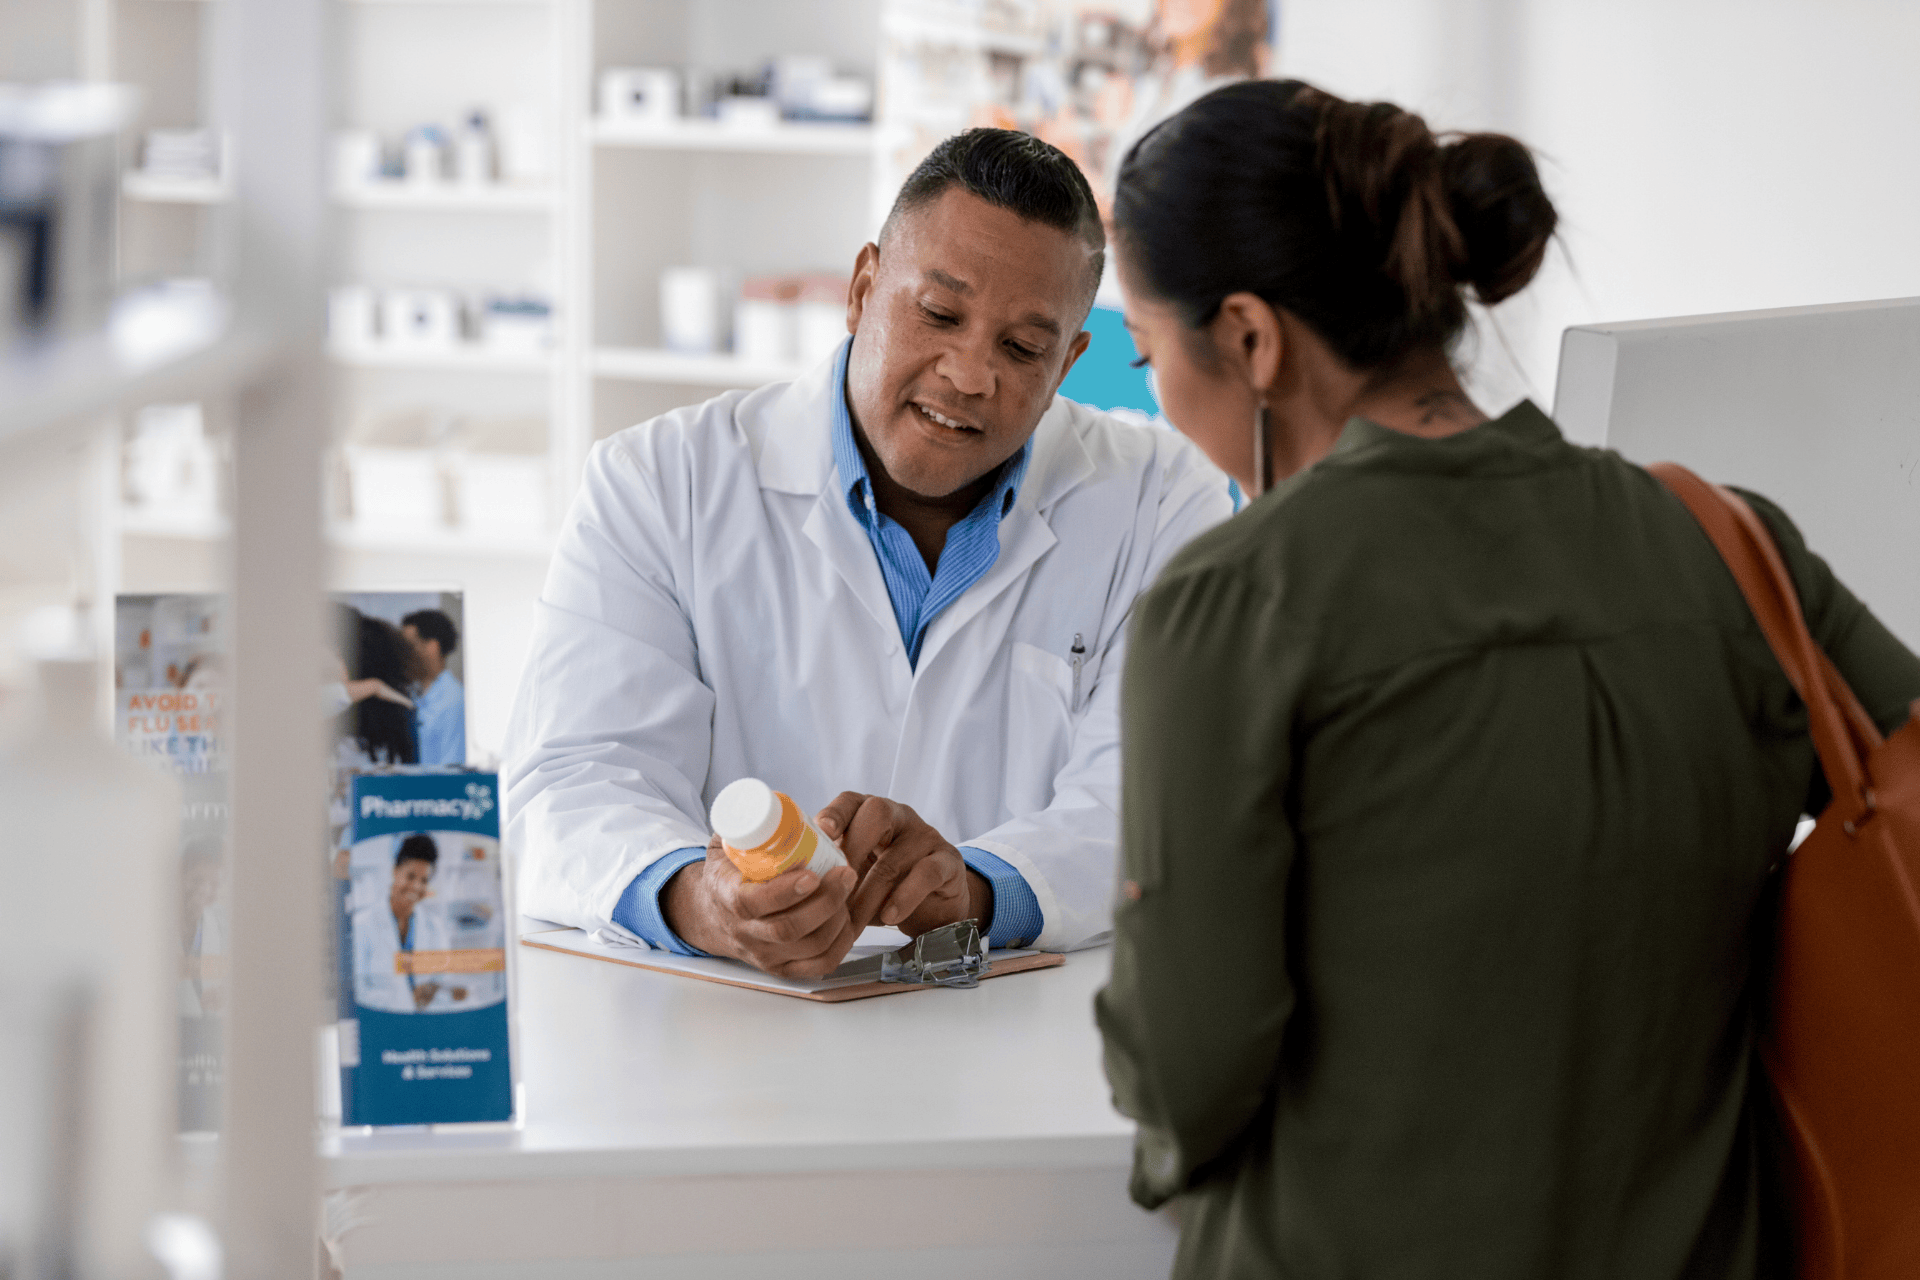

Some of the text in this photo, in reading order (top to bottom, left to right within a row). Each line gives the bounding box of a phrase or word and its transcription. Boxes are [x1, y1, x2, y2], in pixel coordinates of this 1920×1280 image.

[129, 693, 198, 711] AVOID
[128, 715, 170, 733] FLU
[361, 795, 475, 820] Pharmacy
[382, 1048, 491, 1064] Health Solutions
[416, 1064, 473, 1079] Services
